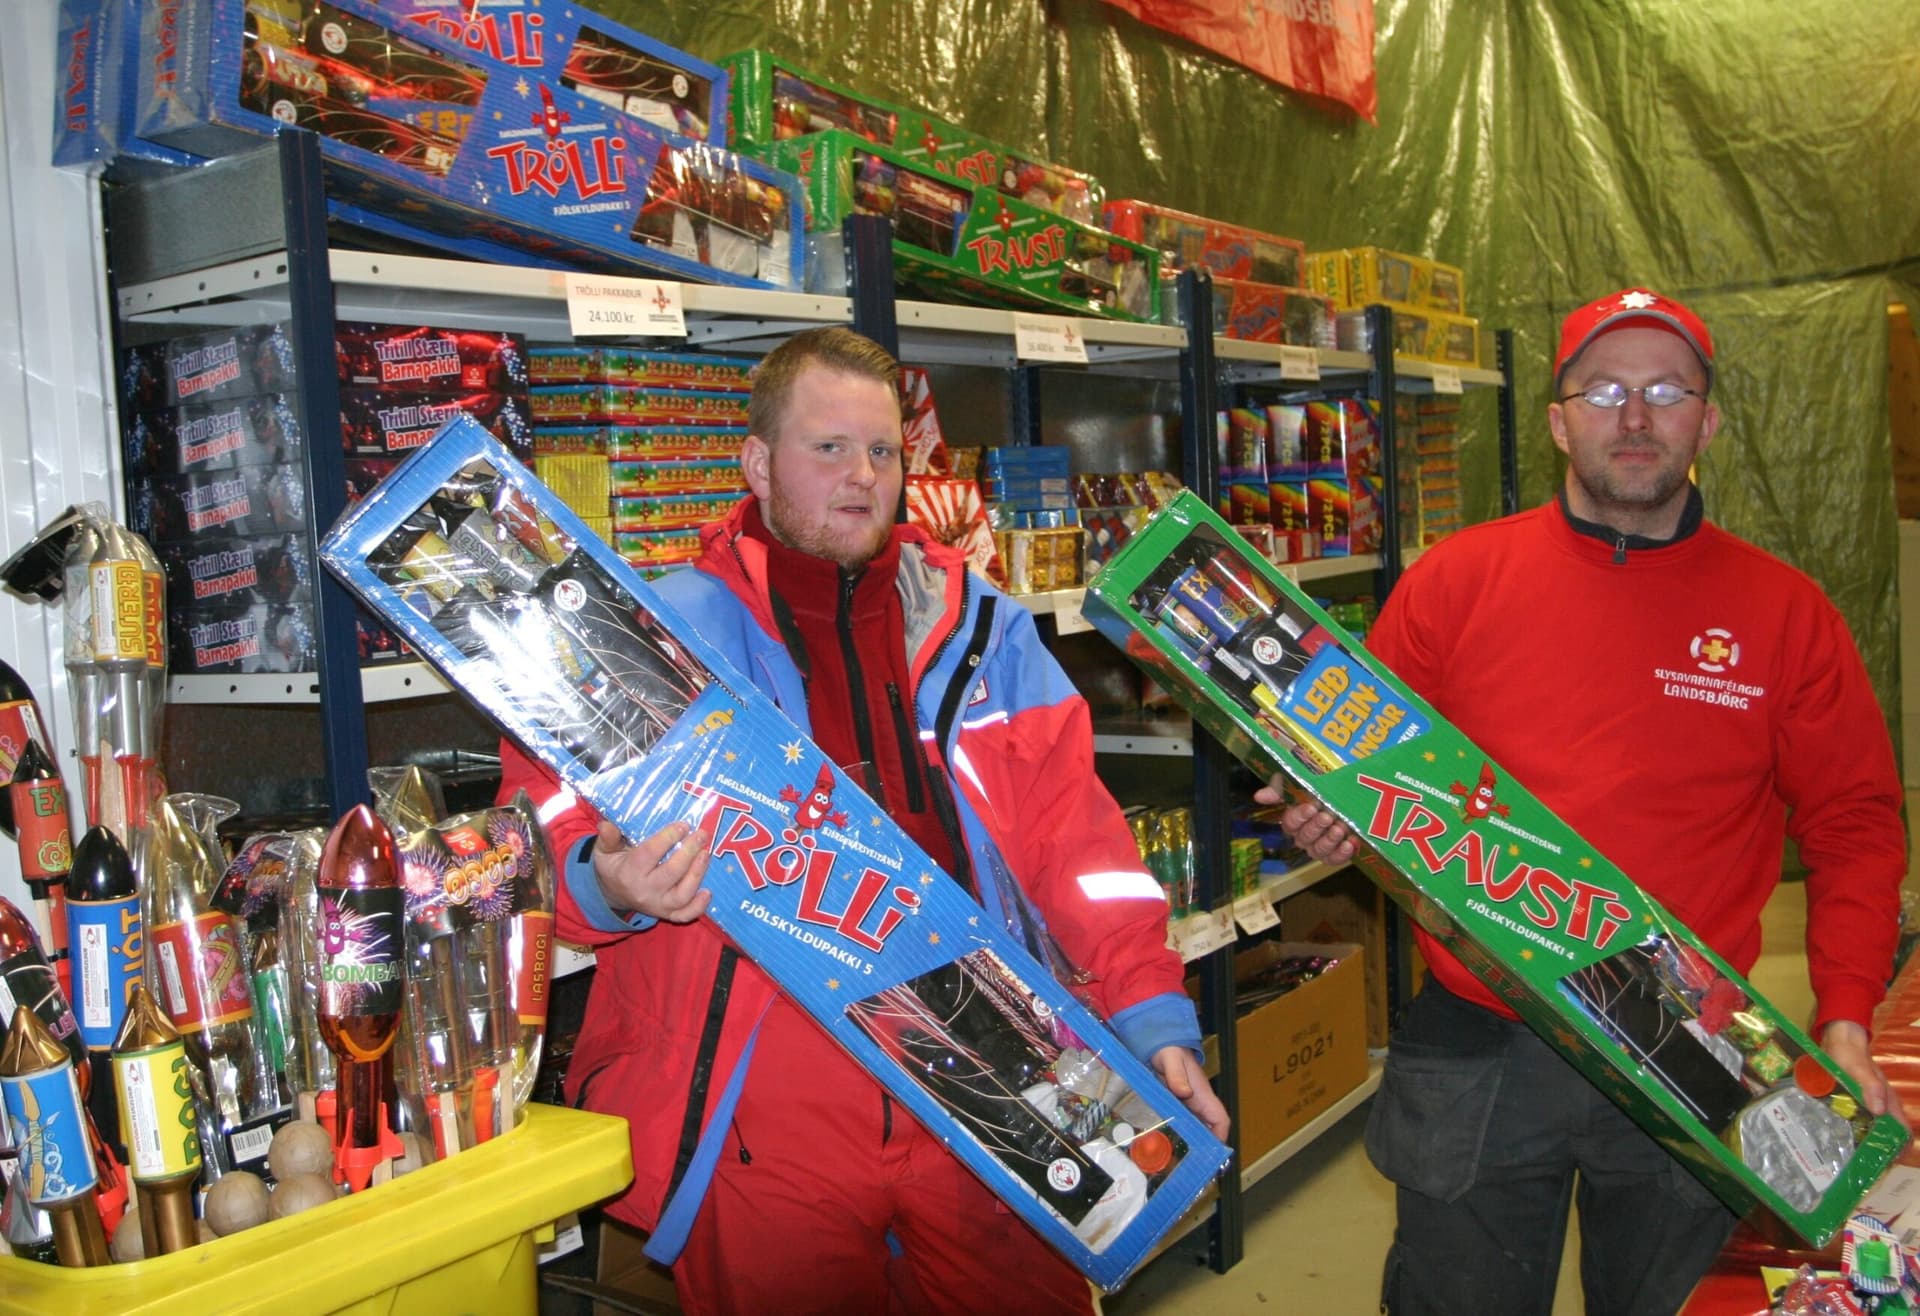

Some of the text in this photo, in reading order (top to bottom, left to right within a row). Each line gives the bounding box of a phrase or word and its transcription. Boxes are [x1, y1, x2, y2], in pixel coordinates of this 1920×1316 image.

[177, 358, 241, 397] Barnapakki
[382, 355, 461, 382] Barnapakki
[530, 357, 549, 373] DS
[647, 360, 741, 380] KIDS BOX
[647, 395, 741, 416] KIDS BOX
[182, 428, 246, 464] Barnapakki
[536, 436, 553, 451] DS
[652, 434, 701, 451] KIDS
[1320, 437, 1332, 464] PCS
[656, 467, 705, 483] KIDS
[661, 502, 709, 517] KIDS
[1323, 515, 1335, 541] PCS
[665, 537, 699, 550] KID
[194, 565, 258, 599] Barnapakki
[196, 636, 260, 667] Barnapakki
[1664, 683, 1750, 711] LANDSBJÖRG
[1351, 702, 1407, 760] INGAR
[740, 899, 874, 975] FJÖLSKYLDUPAKKI 5
[1466, 898, 1576, 961] FJÖLSKYLDUPAKKI 4
[321, 961, 400, 984] BOMBA
[1272, 1031, 1335, 1085] L9021
